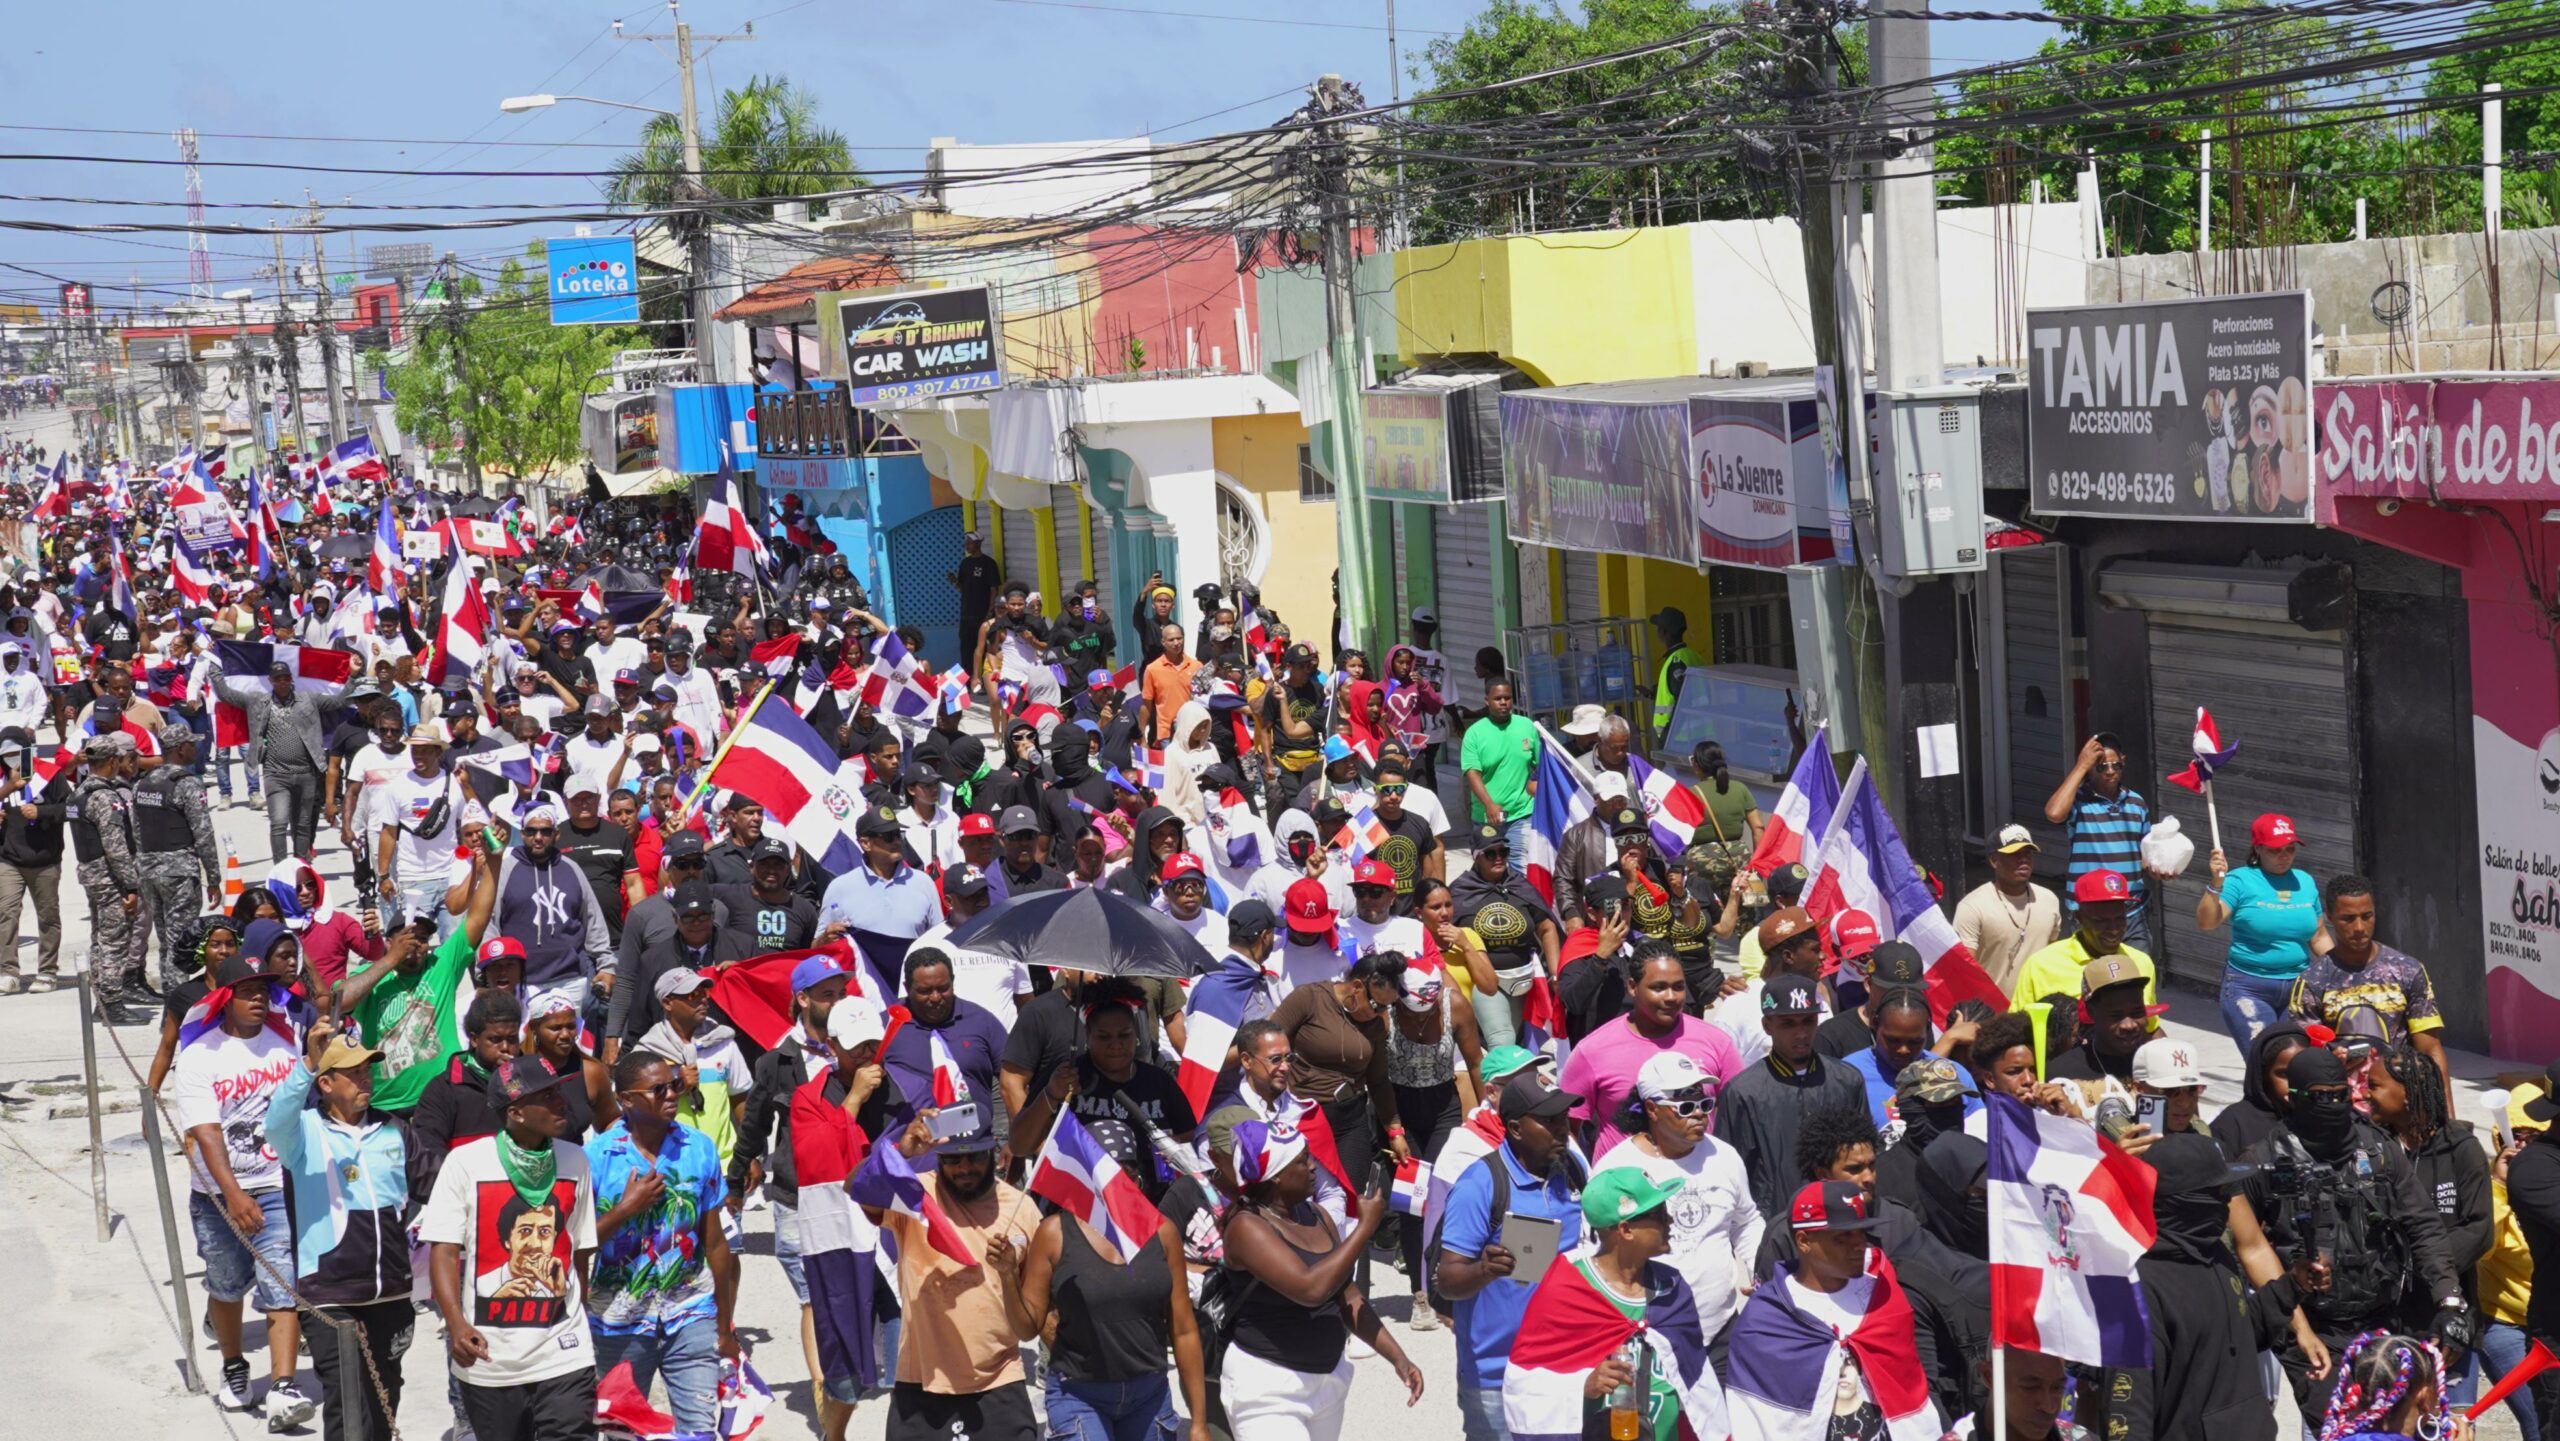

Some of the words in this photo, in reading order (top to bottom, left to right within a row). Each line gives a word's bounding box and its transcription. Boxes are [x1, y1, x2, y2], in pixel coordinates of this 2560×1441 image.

[556, 274, 629, 294] Loteka
[921, 319, 986, 344] BRIANNY
[2212, 315, 2274, 334] Perforaciones
[853, 351, 904, 376] CAR
[915, 340, 989, 368] WASH
[2206, 342, 2233, 358] Acero
[2233, 338, 2281, 357] inoxidable
[874, 375, 894, 383] LA
[902, 364, 973, 379] TABLITA
[2034, 321, 2188, 409] TAMIA
[2208, 366, 2232, 381] Plata
[2232, 364, 2253, 380] 9.25
[2254, 367, 2260, 383] y
[2261, 362, 2280, 379] Más
[877, 374, 993, 400] 809.307.4774
[2069, 411, 2153, 435] ACCESORIOS
[2322, 391, 2448, 485] Salón
[2455, 398, 2513, 485] de
[1718, 453, 1734, 490] La
[2061, 471, 2175, 503] 829-498-6326
[1752, 499, 1787, 516] DOMINICANA
[2485, 844, 2513, 870] Salón
[2515, 850, 2529, 873] de
[757, 909, 787, 936] 60
[757, 935, 785, 943] EARTH
[2436, 1189, 2457, 1198] OCIAL
